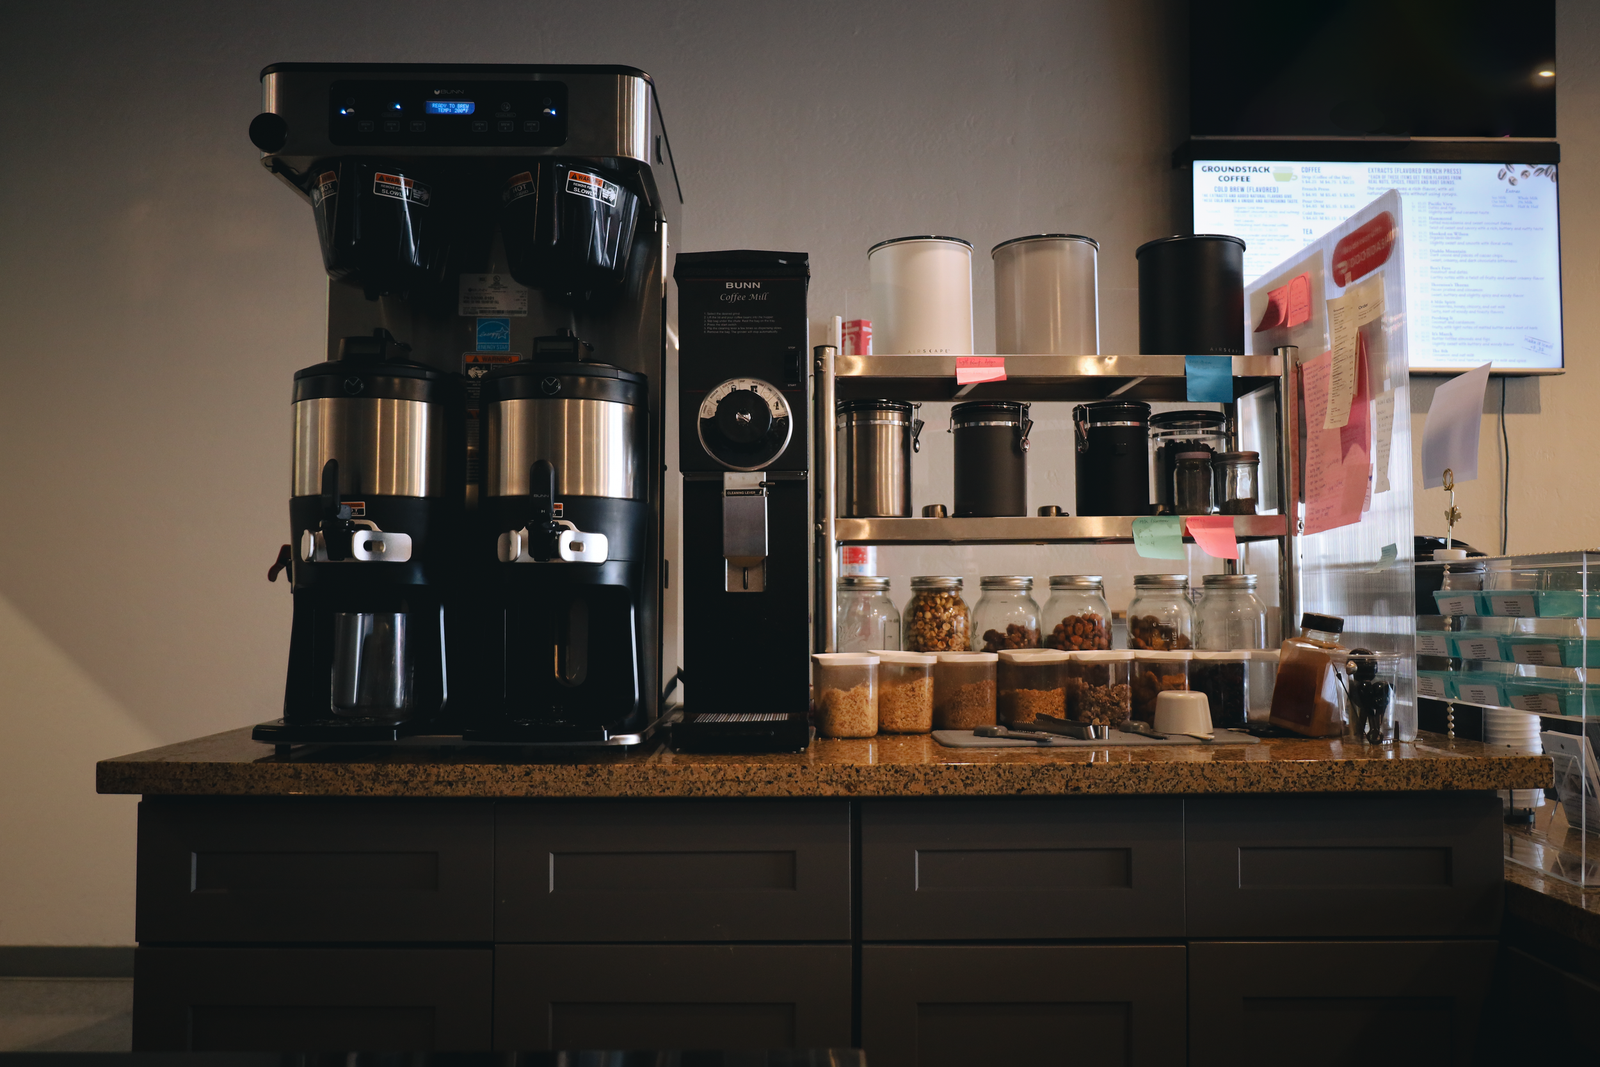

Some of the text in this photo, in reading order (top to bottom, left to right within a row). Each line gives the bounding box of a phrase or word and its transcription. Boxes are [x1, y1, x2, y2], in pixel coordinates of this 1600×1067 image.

[386, 176, 411, 186] WARNG
[513, 184, 527, 193] HOT
[720, 292, 769, 304] Coffee Mill
